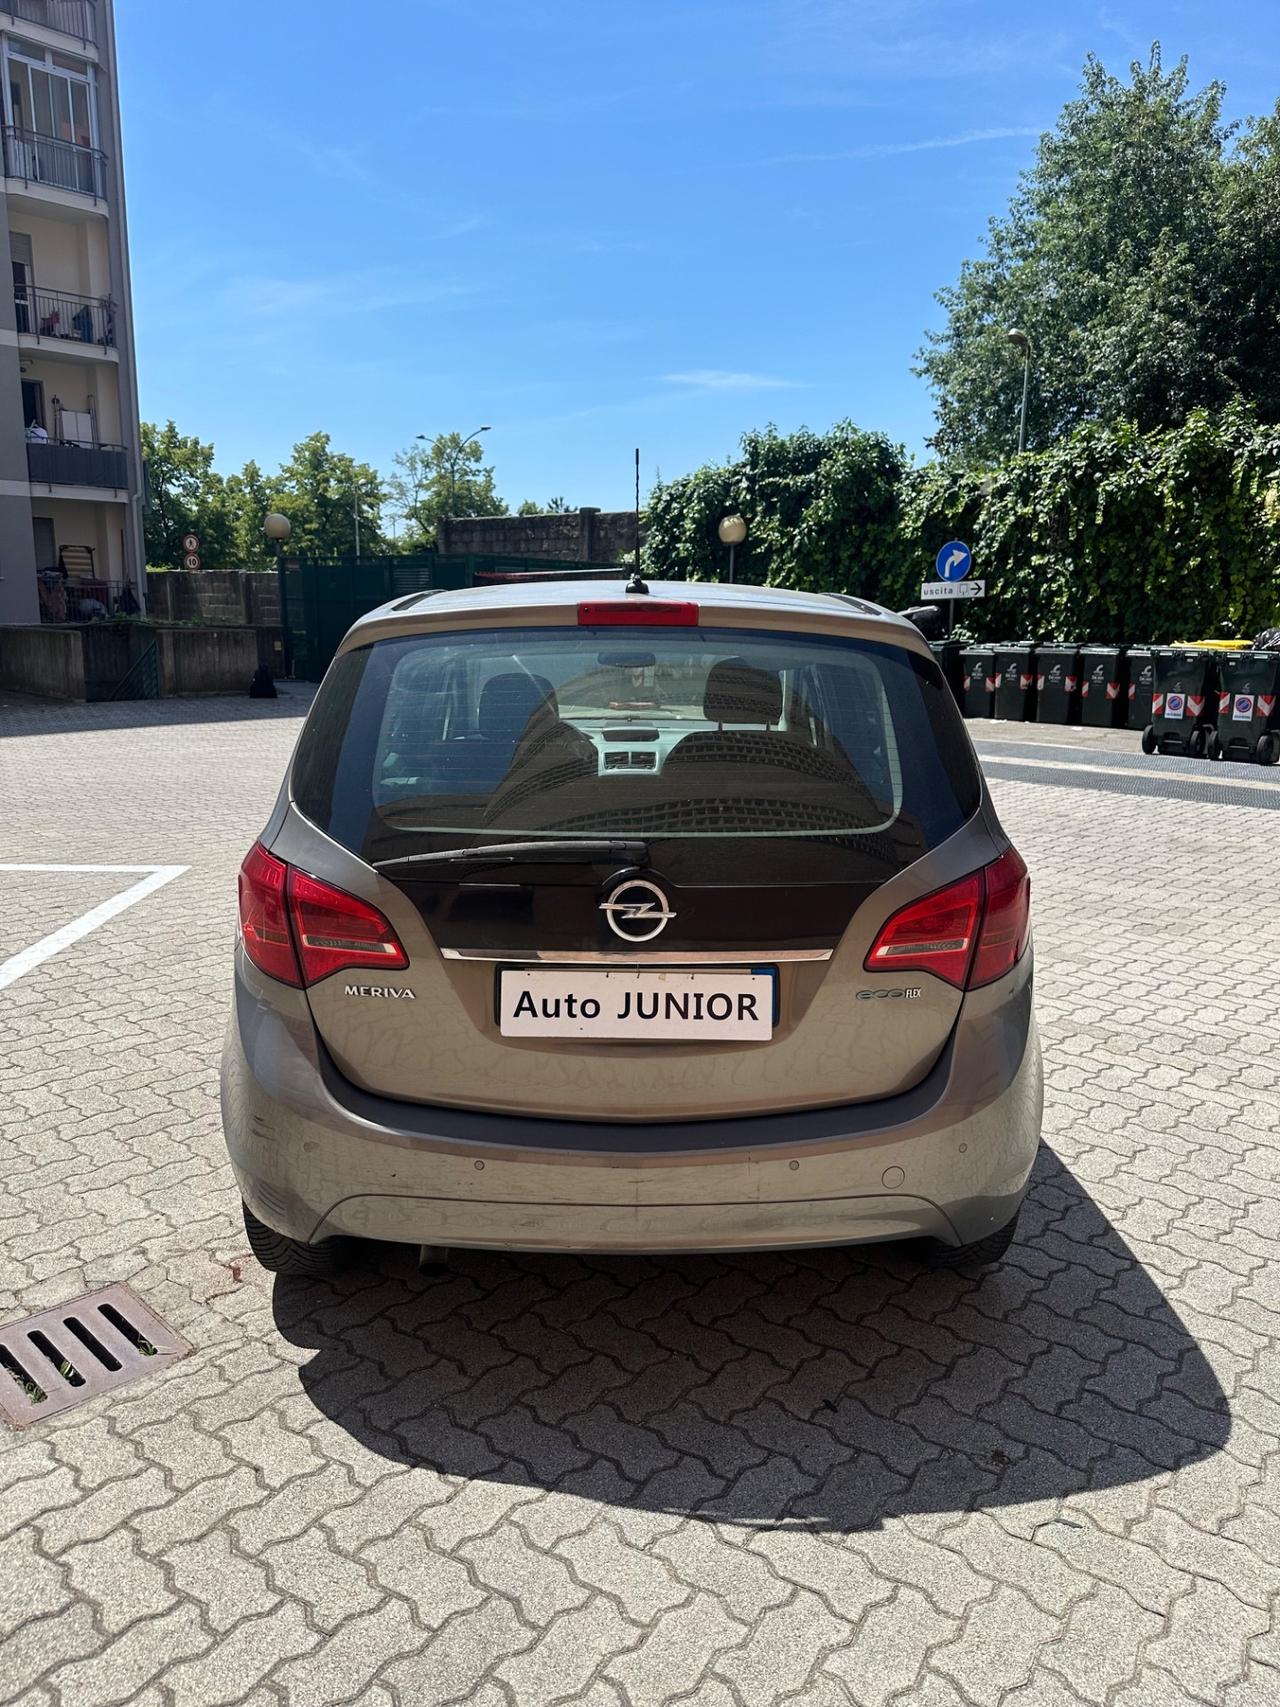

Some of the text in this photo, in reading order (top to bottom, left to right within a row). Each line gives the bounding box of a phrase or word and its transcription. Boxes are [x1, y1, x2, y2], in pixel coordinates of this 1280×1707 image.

[188, 558, 197, 566] 10
[923, 586, 954, 596] uscita
[344, 985, 416, 999] MERIVA
[513, 990, 759, 1021] Auto JUNIOR
